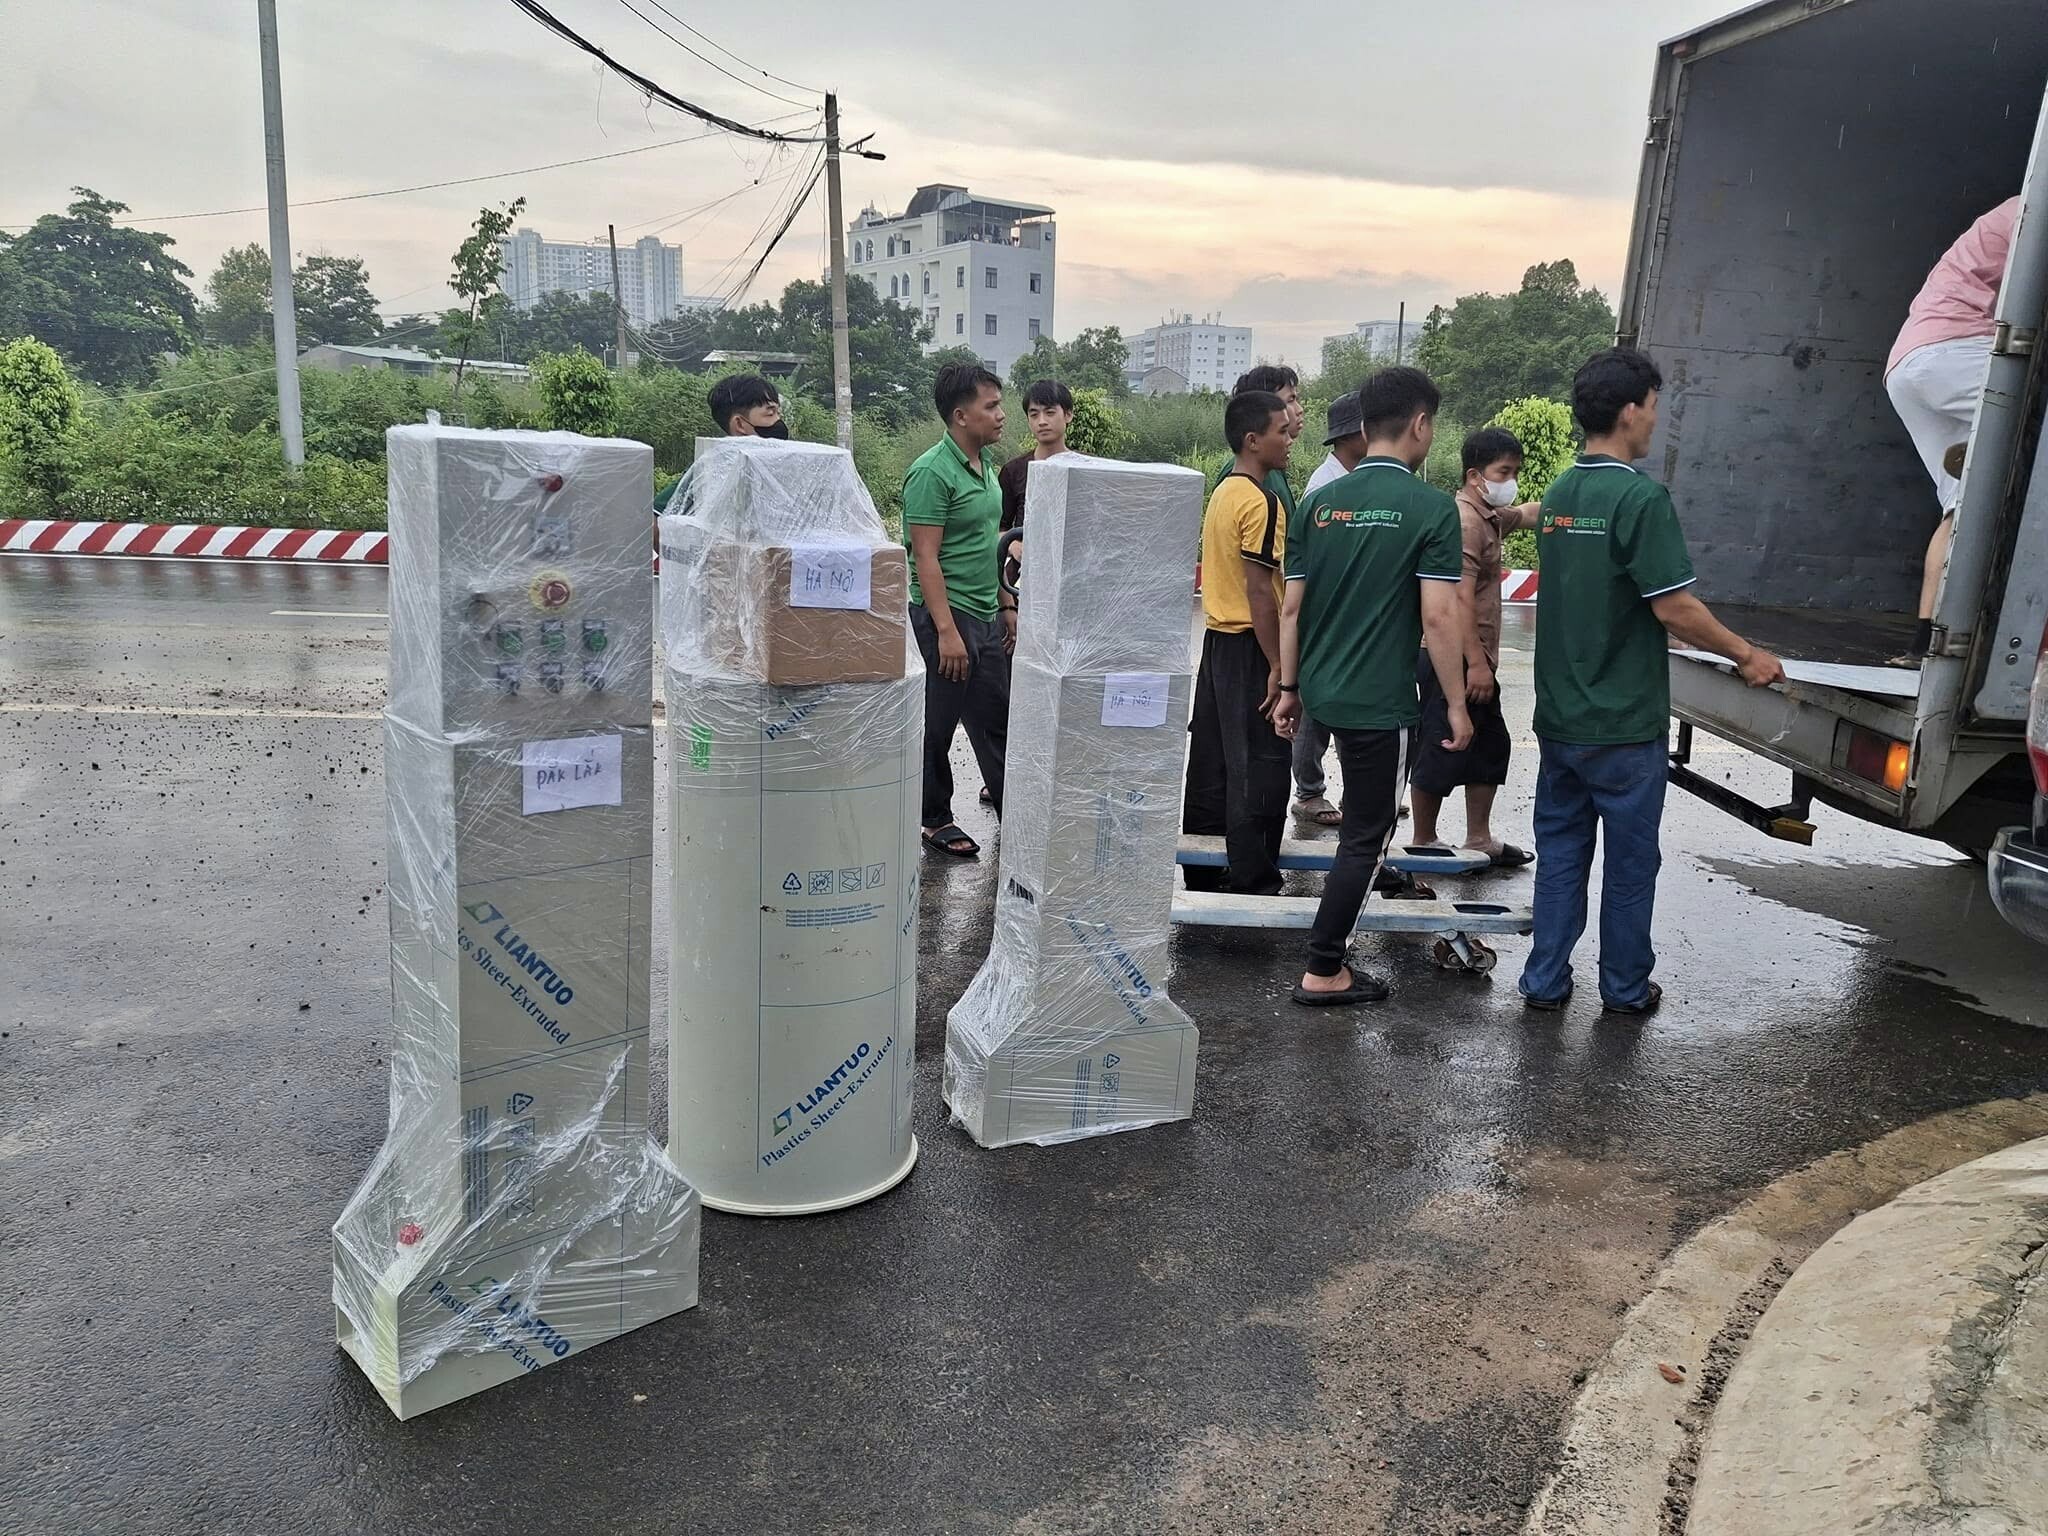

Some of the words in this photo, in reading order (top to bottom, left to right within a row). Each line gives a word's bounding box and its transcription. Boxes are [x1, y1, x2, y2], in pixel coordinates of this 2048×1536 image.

[1331, 509, 1402, 522] REGREEN
[1555, 516, 1606, 529] REGEEN
[471, 946, 571, 1045] Sheet-Extruded
[494, 924, 574, 1006] LIANTUO
[762, 1127, 812, 1167] Plastics
[810, 1036, 894, 1130] Sheet-Extruded
[796, 1042, 870, 1114] LIANTUO
[429, 1280, 478, 1319] Plasti
[497, 1294, 571, 1357] LITUO
